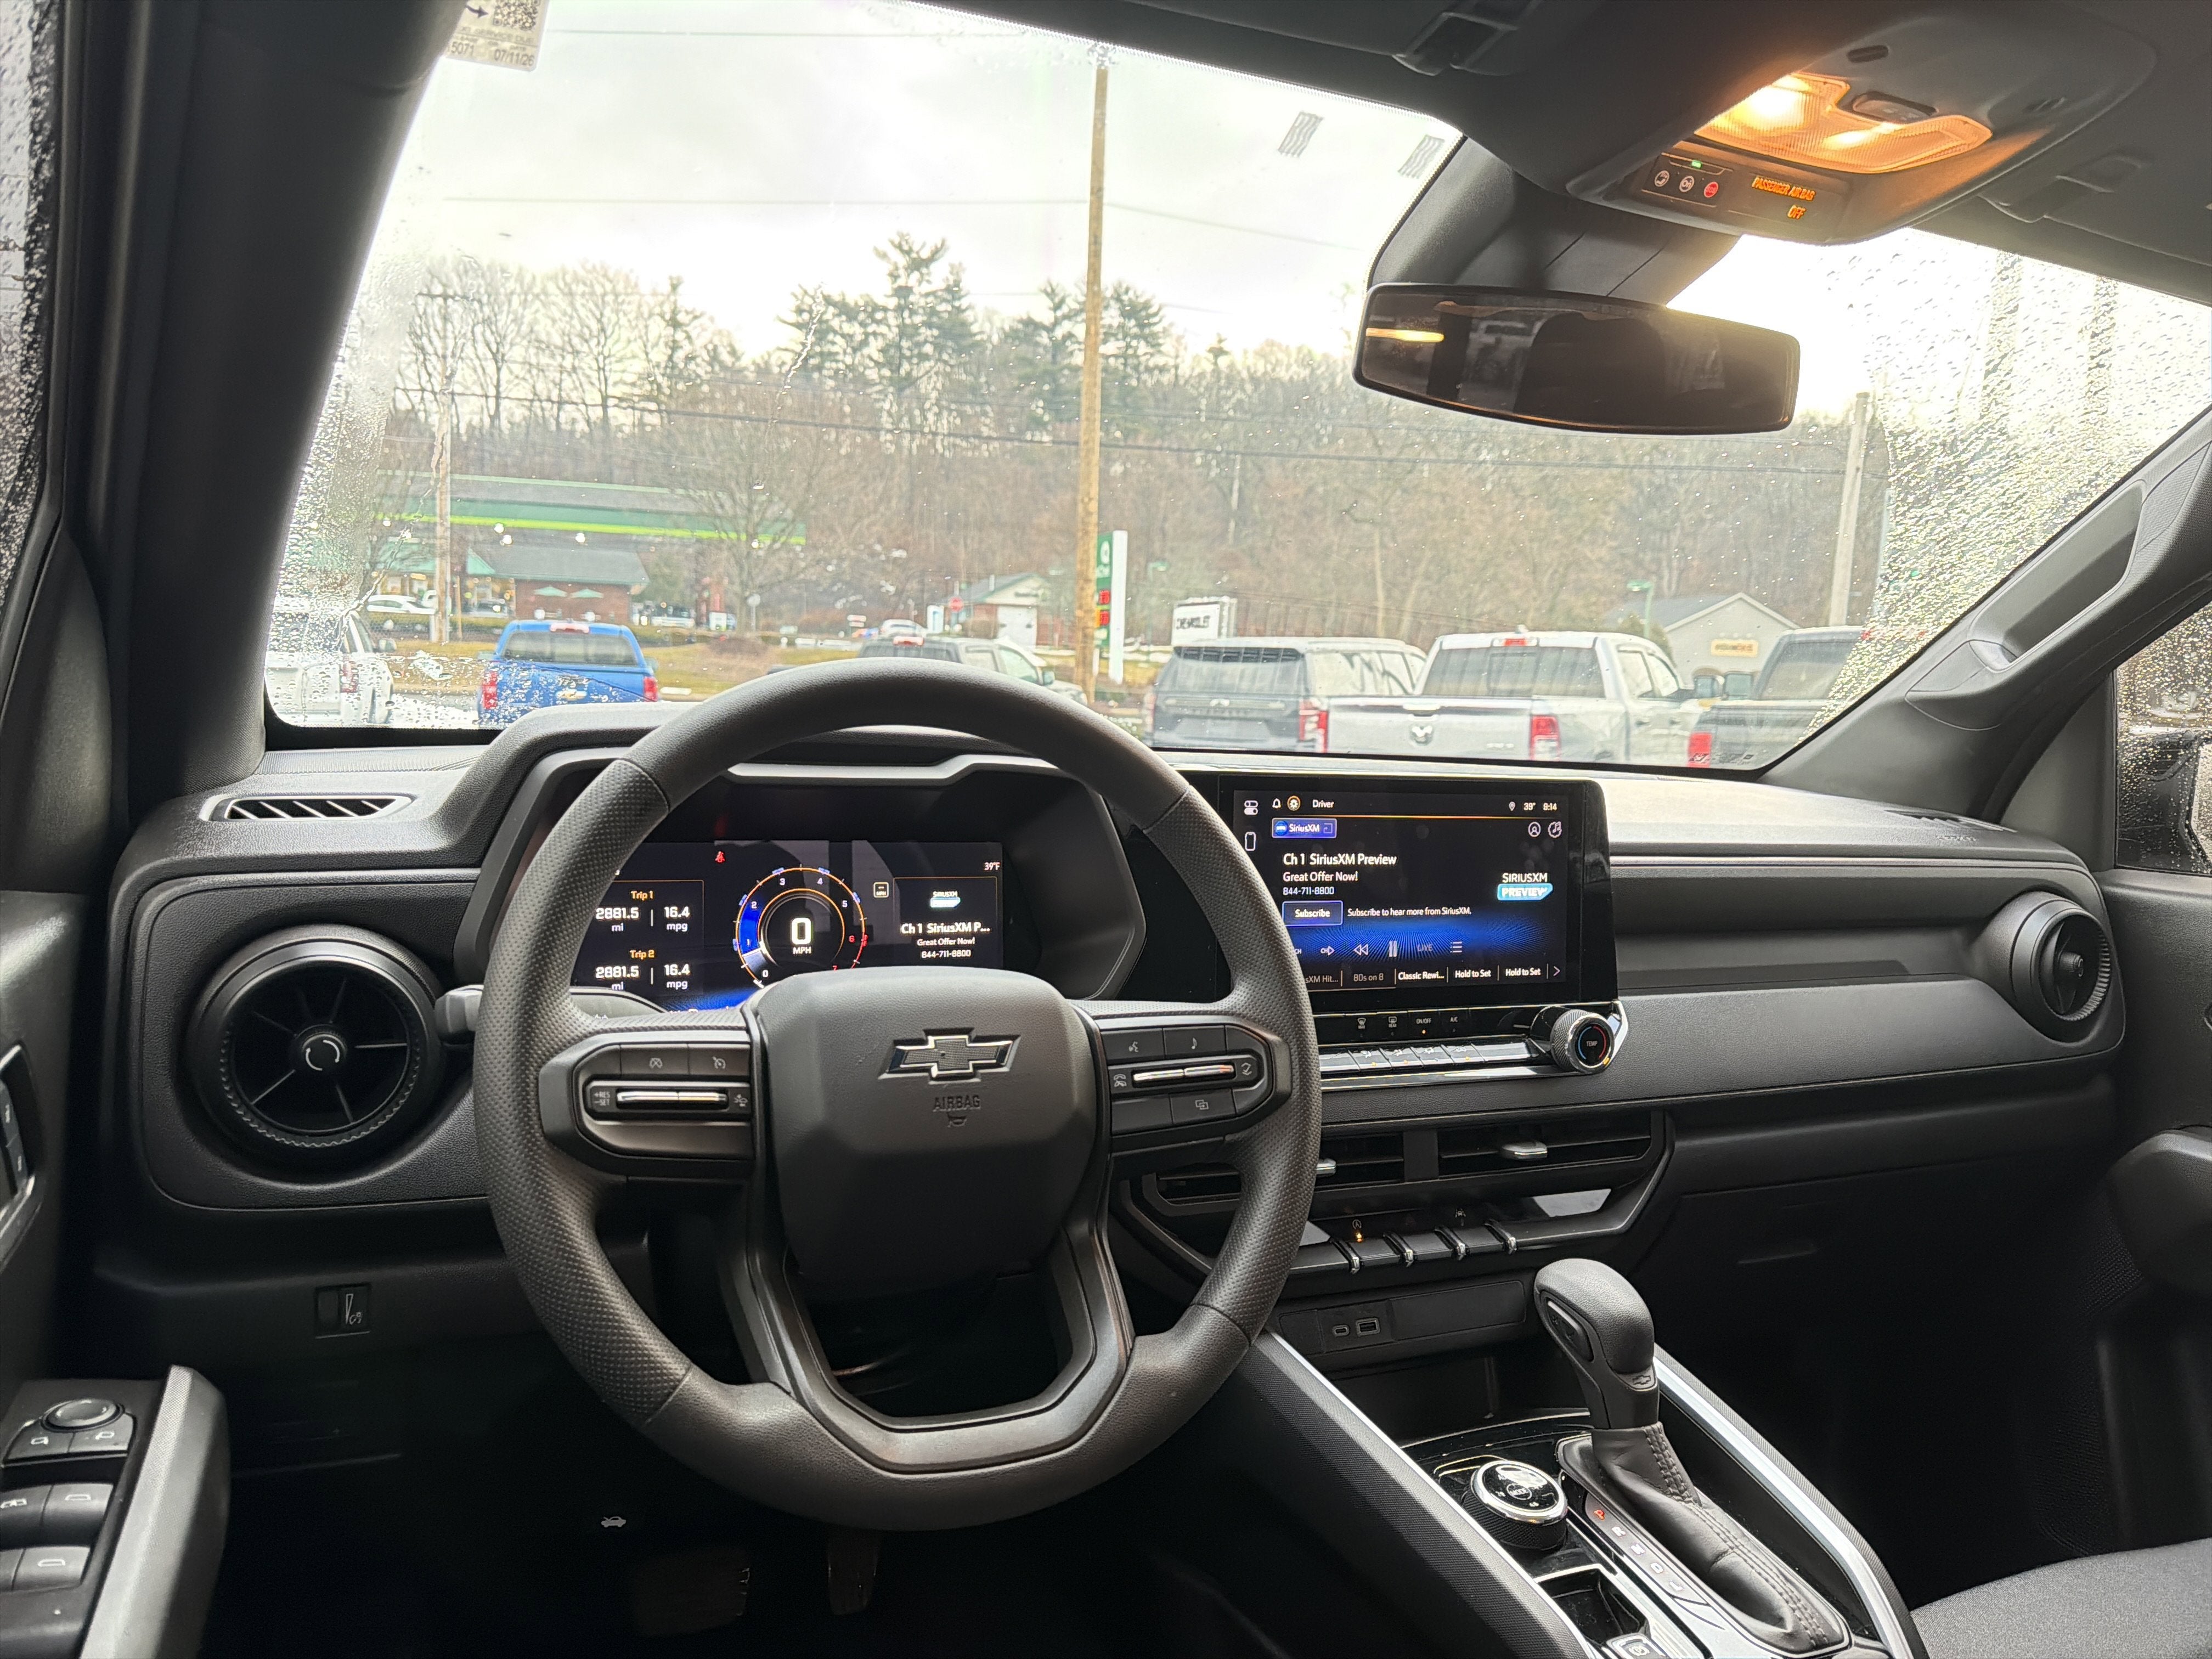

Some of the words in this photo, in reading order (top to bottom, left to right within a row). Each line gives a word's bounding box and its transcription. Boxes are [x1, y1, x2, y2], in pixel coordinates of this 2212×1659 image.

[494, 49, 535, 66] 07/11/26
[1752, 176, 1790, 195] PASSENGER
[1787, 205, 1807, 219] OFF
[1312, 799, 1334, 808] Driver
[1289, 823, 1320, 832] SiriusXM
[1283, 853, 1298, 865] Ch
[1300, 854, 1305, 865] 1
[1310, 853, 1356, 865] SiriusXM
[1357, 854, 1397, 865] Preview
[1283, 871, 1308, 882] Great
[1310, 871, 1334, 882] Offer
[1335, 870, 1359, 882] Now!
[1502, 872, 1548, 883] SIRIUSXM
[631, 890, 648, 901] Trip
[650, 890, 654, 899] 1
[1283, 887, 1335, 895] 844-711-8800
[1502, 887, 1548, 898] PREVIEW
[751, 901, 757, 909] 2
[595, 907, 639, 919] 2881.5
[664, 906, 690, 918] 16.4
[1295, 909, 1330, 918] Subscribe
[1347, 908, 1380, 917] Subscribe
[1390, 908, 1405, 916] hear
[1425, 907, 1441, 916] from
[1442, 907, 1472, 915] SiriusXM.
[611, 923, 624, 932] mi
[666, 923, 689, 932] mpg
[791, 917, 812, 945] 0
[901, 923, 915, 934] Ch
[917, 923, 923, 933] 1
[927, 922, 972, 933] SiriusXM
[973, 922, 990, 933] P...
[849, 935, 855, 943] 6
[917, 938, 937, 946] Great
[938, 937, 957, 946] Offer
[957, 936, 975, 945] Now!
[1417, 944, 1434, 952] LIVE
[630, 950, 647, 960] Trip
[648, 950, 655, 958] 2
[921, 949, 972, 958] 844-711-8800
[595, 966, 639, 979] 2881.5
[664, 964, 690, 976] 16.4
[762, 969, 769, 978] 0
[1455, 970, 1471, 979] Hold
[1480, 969, 1492, 978] Set
[1505, 968, 1521, 977] Hold
[1530, 968, 1541, 976] Set
[1353, 973, 1367, 982] 80s
[1379, 973, 1384, 981] 8
[1398, 972, 1421, 980] Classic
[611, 981, 624, 991] mi
[666, 981, 689, 990] mpg
[933, 1095, 980, 1111] AIRBAG
[1612, 1526, 1626, 1537] R
[1669, 1581, 1683, 1592] L
